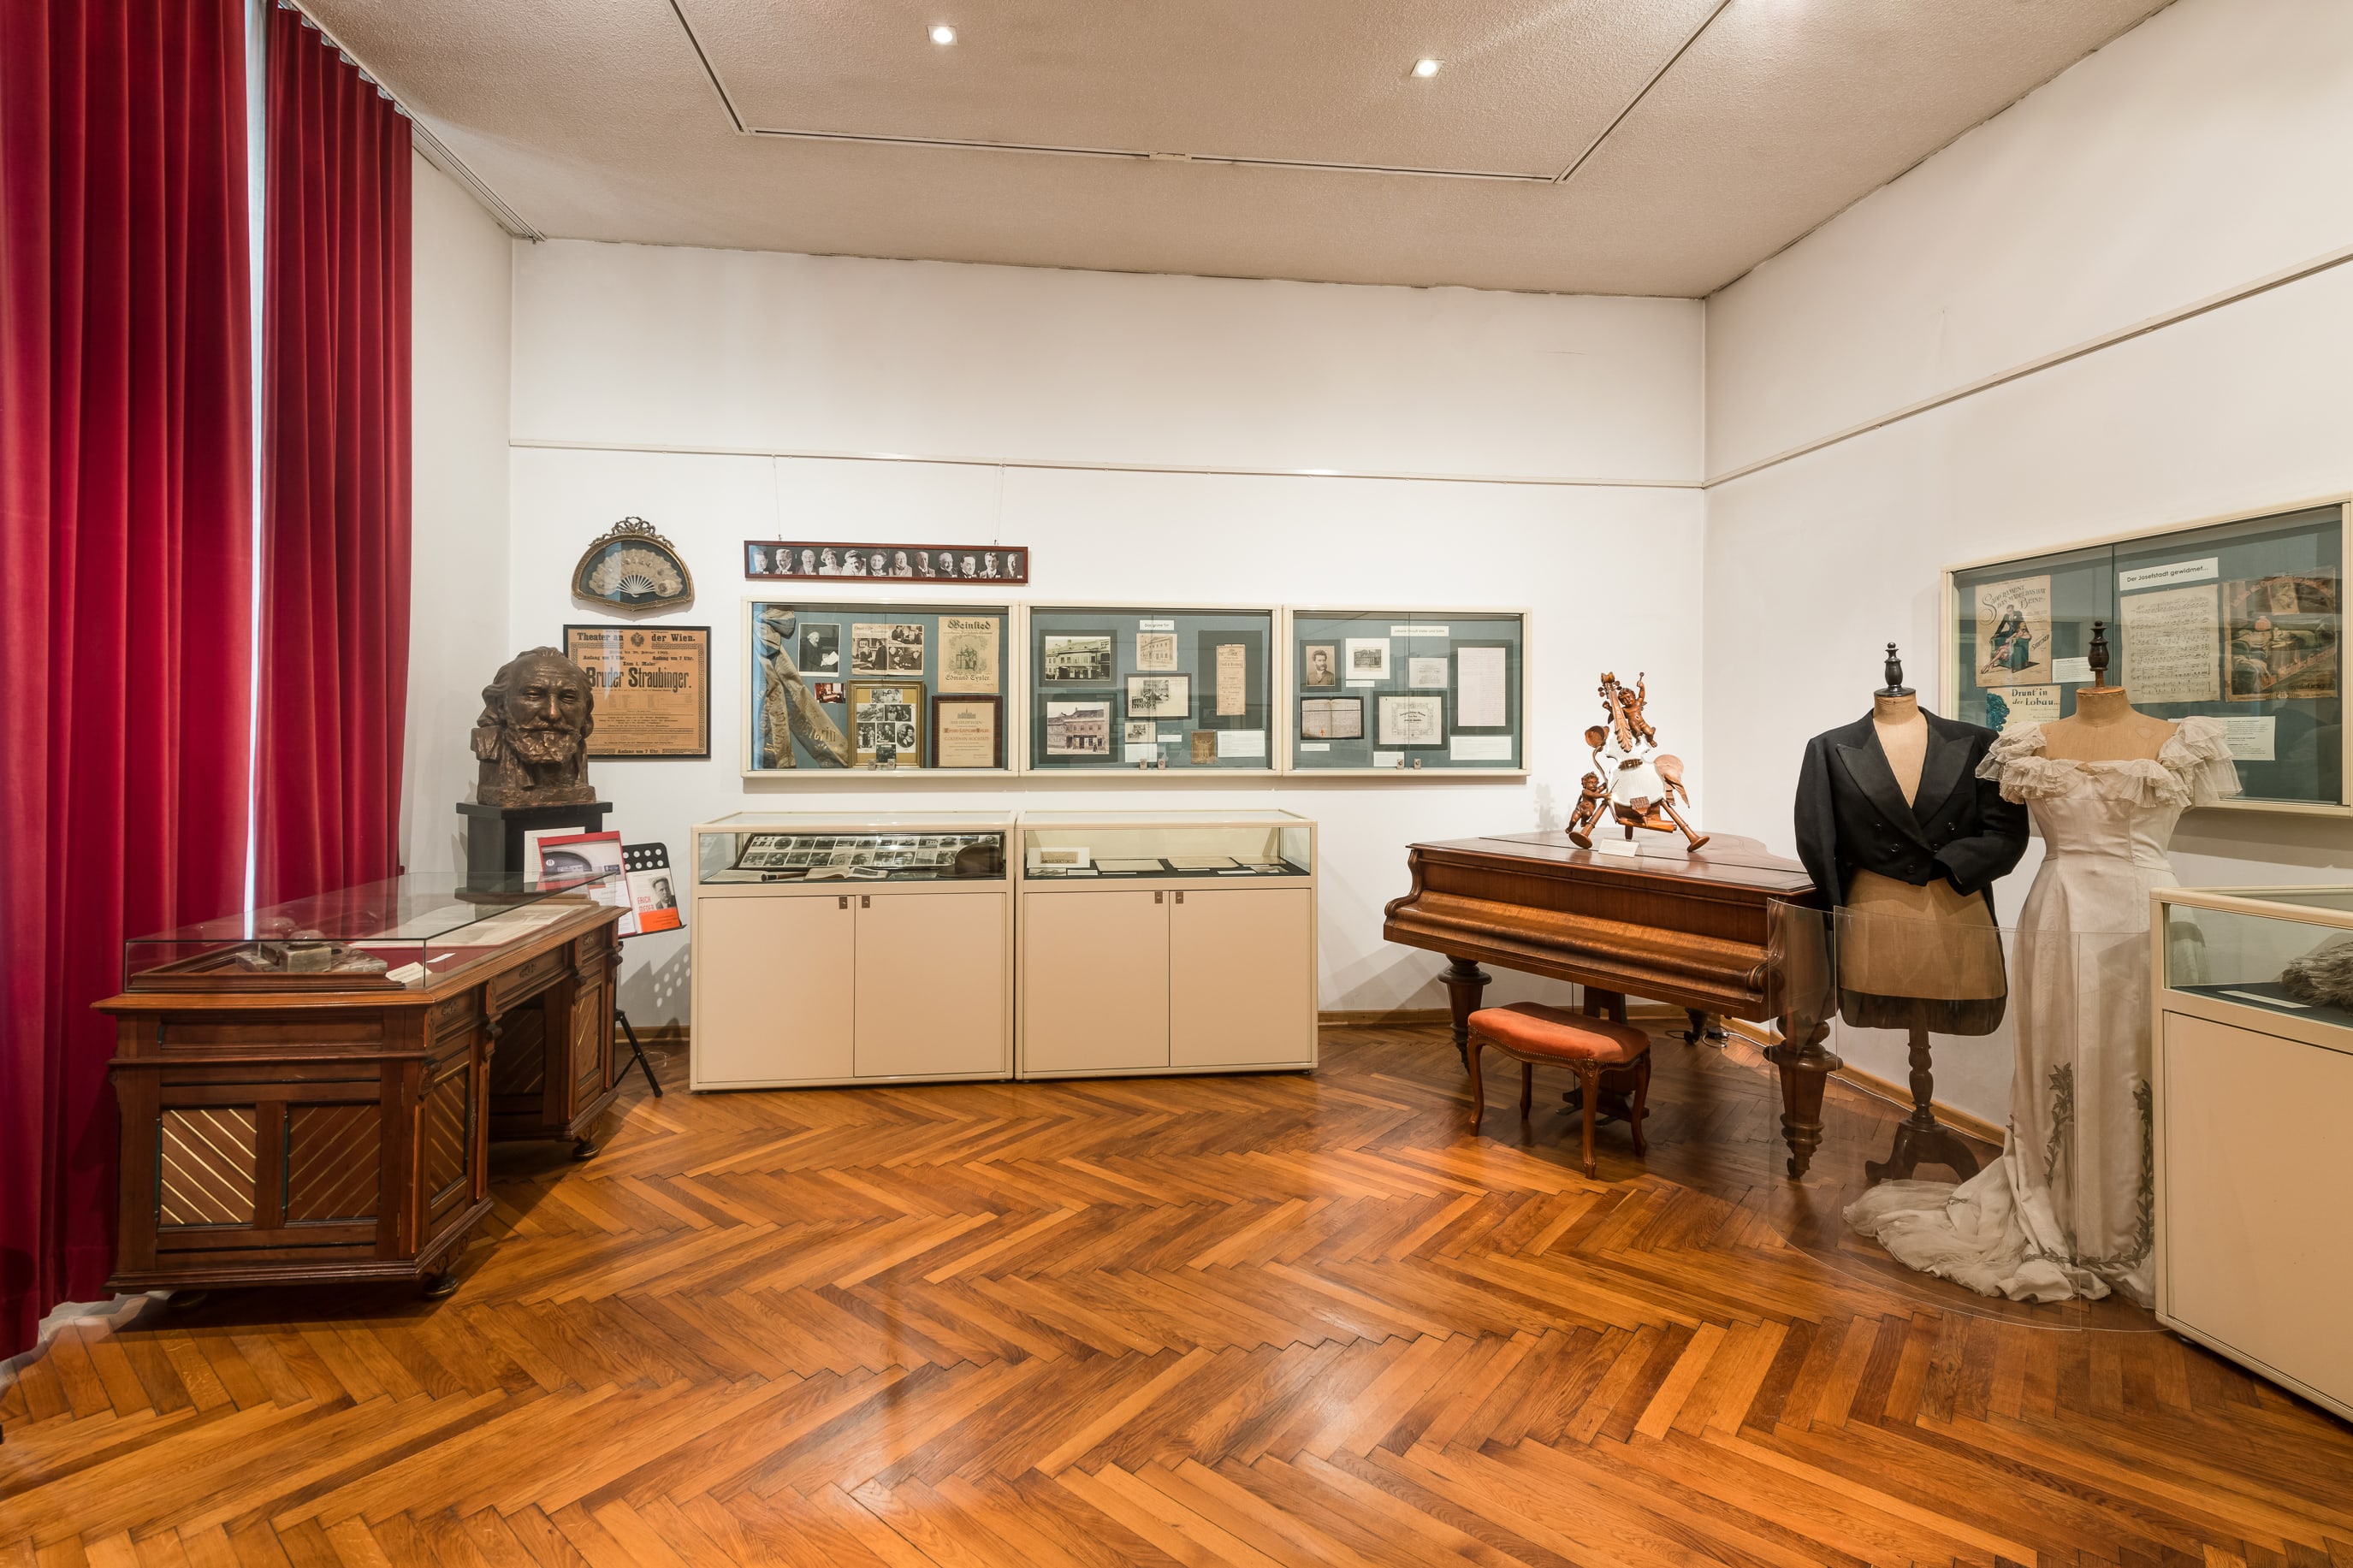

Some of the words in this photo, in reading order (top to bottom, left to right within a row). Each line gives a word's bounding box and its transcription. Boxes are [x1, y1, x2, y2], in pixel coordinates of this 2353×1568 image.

[2138, 571, 2169, 581] Josefstadt
[947, 619, 991, 630] Weinlied
[577, 632, 610, 641] Theater
[651, 633, 667, 642] der
[671, 633, 696, 642] Wien.
[585, 666, 625, 688] Bruder
[628, 666, 692, 693] Straubinger.
[2039, 688, 2048, 696] in
[637, 896, 651, 904] ERICH
